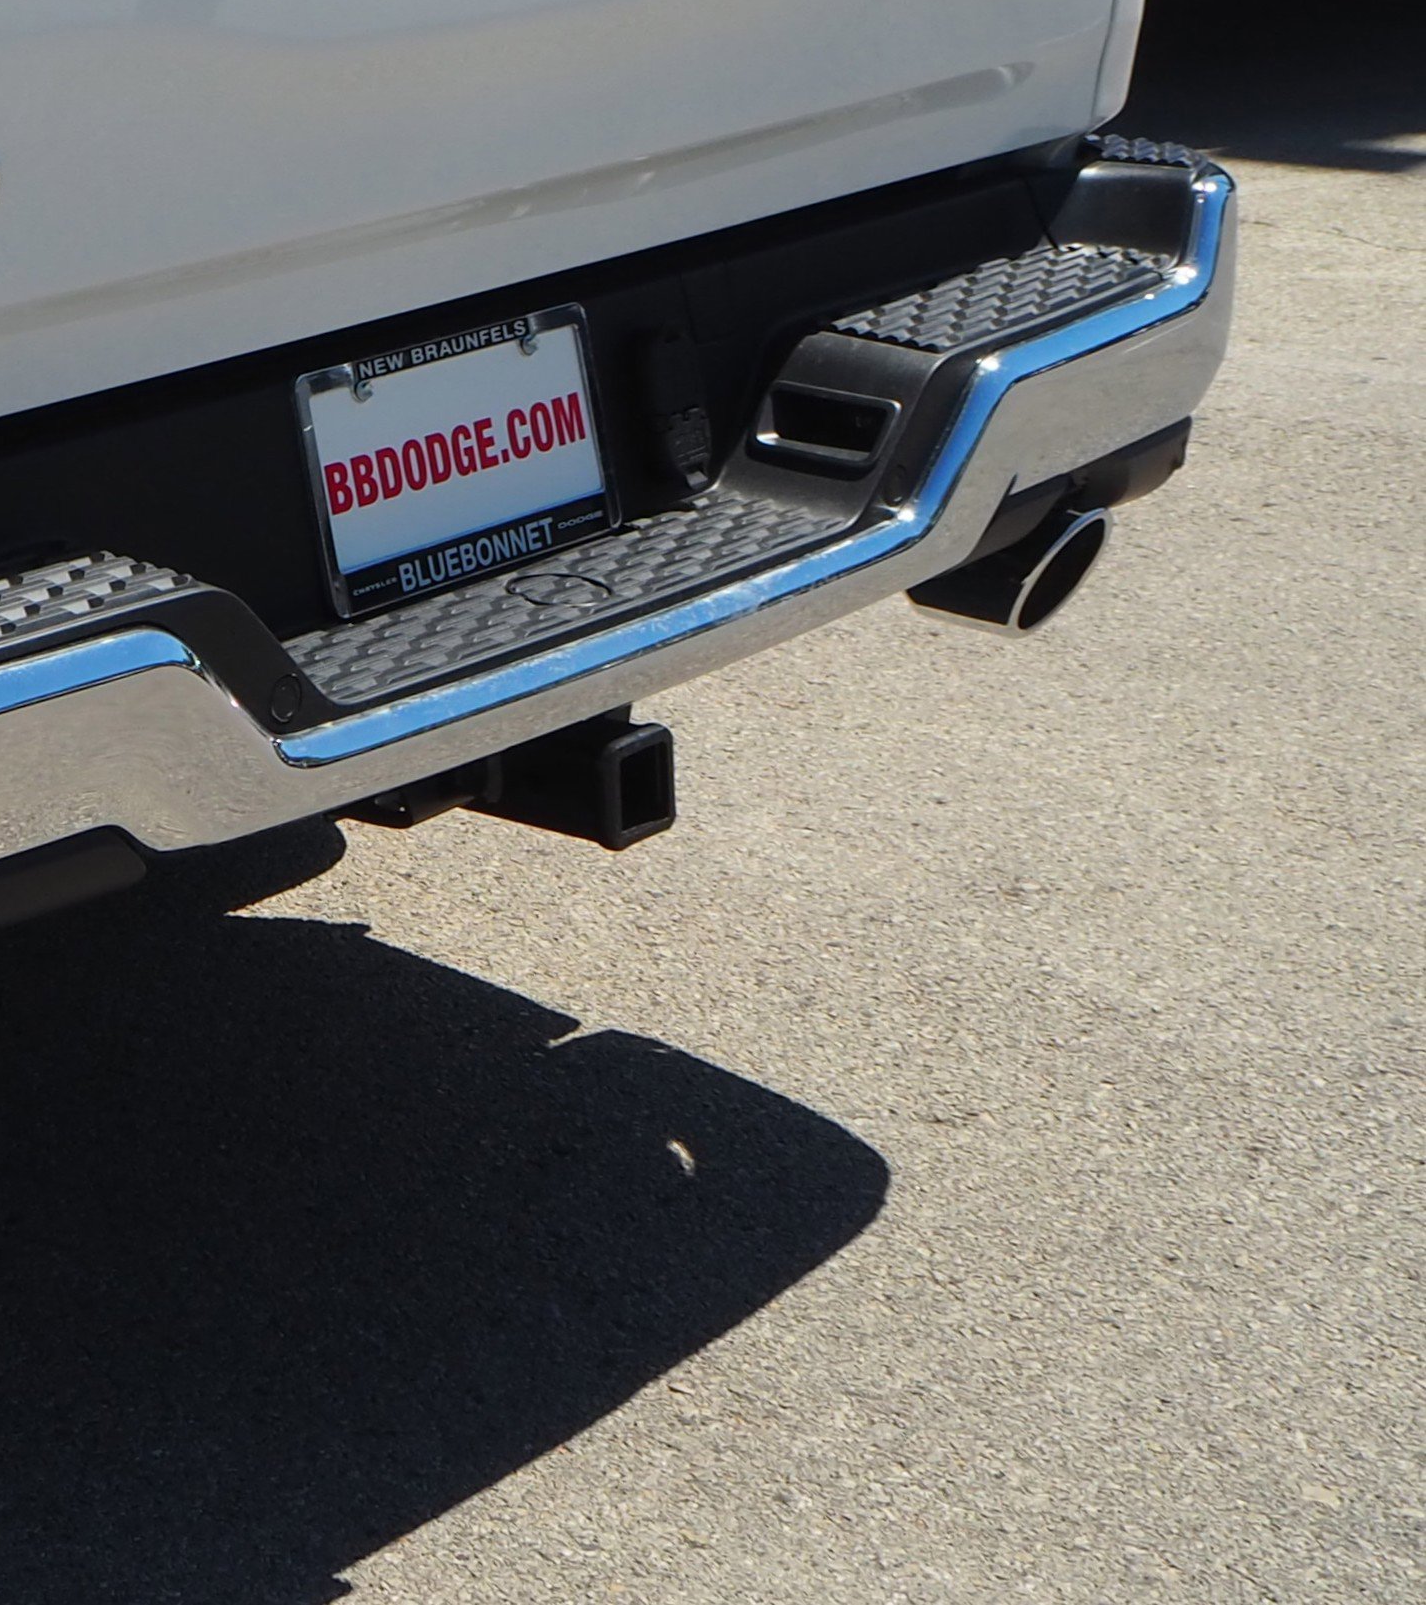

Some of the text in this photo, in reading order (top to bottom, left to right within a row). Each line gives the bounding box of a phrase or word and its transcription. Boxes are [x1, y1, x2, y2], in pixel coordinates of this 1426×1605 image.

[359, 320, 526, 379] NEW BRAUNFELS
[324, 392, 586, 515] BBDODGE.COM
[398, 517, 553, 593] BLUEBONNET
[557, 510, 604, 530] DODGE
